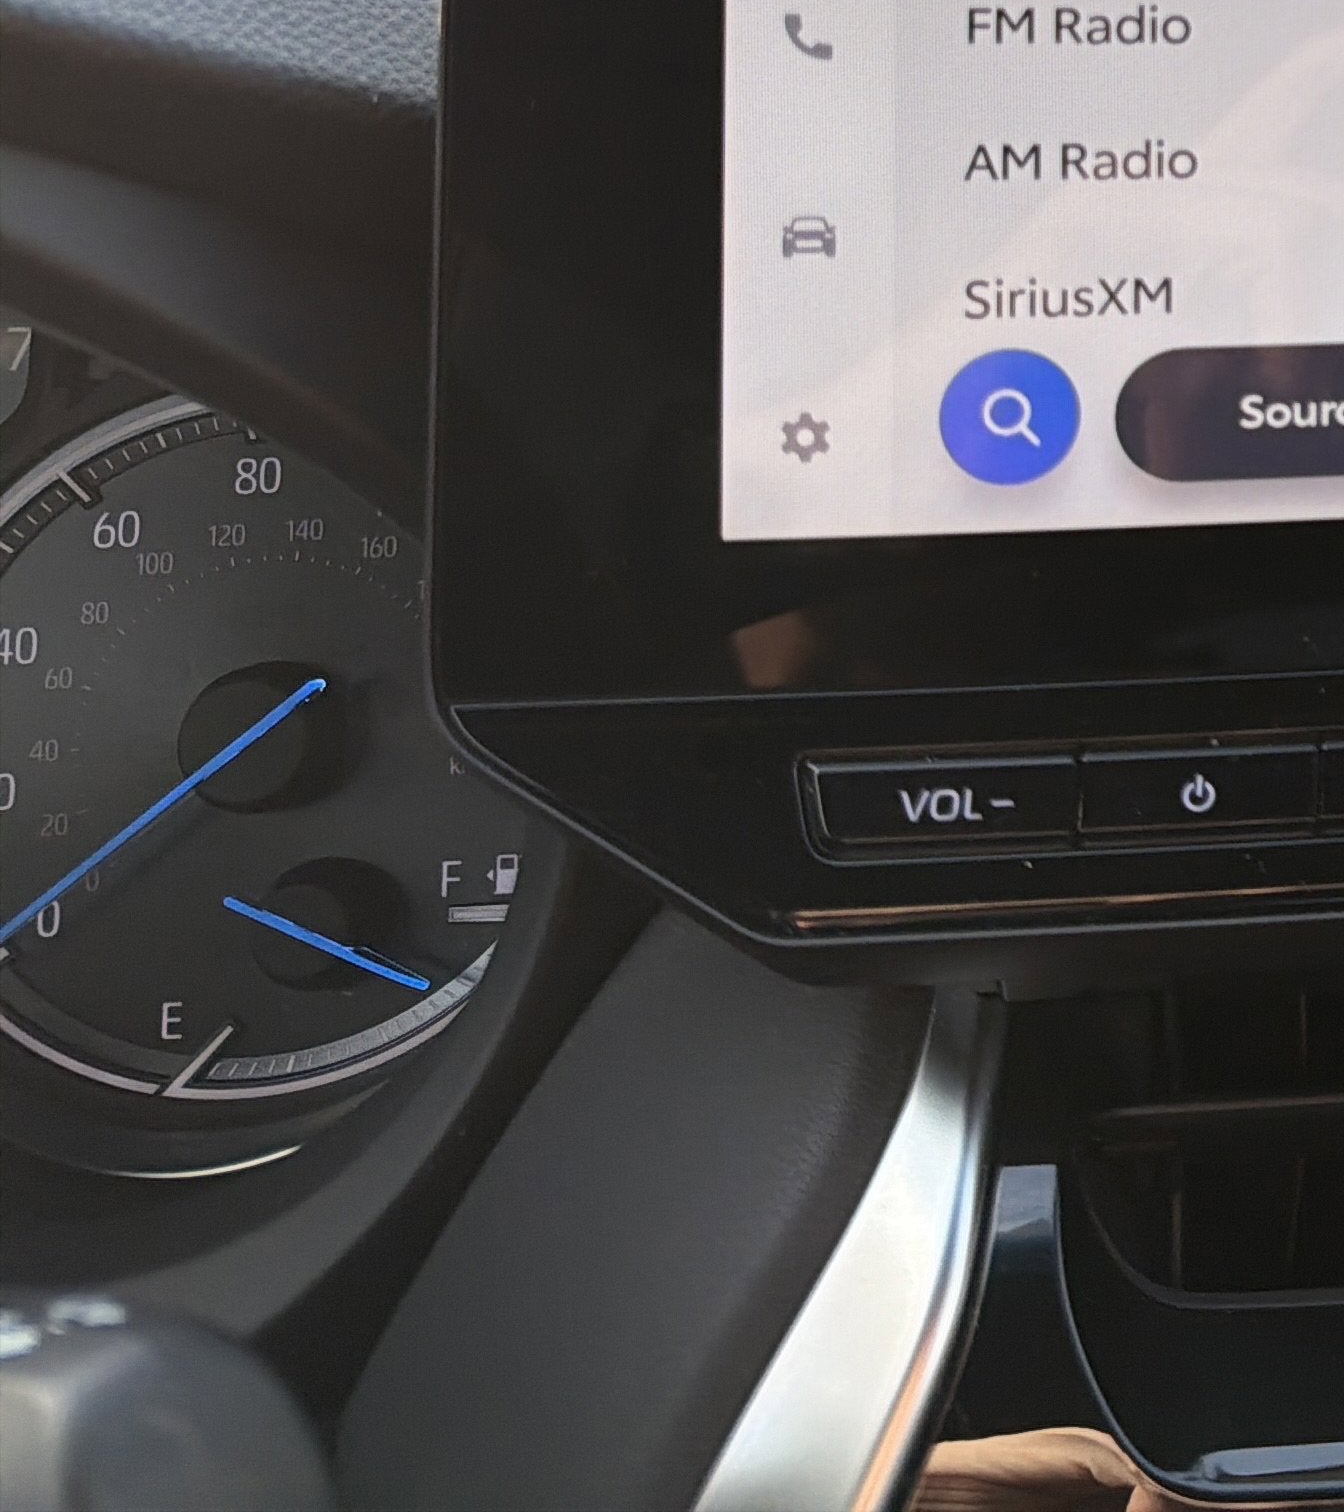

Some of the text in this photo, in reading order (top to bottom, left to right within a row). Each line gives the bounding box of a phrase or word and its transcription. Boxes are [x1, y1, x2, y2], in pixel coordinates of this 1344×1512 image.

[966, 3, 1191, 45] FM Radio
[964, 140, 1198, 182] AM Radio
[963, 276, 1174, 319] SiriusXM
[234, 457, 282, 495] 80
[93, 510, 141, 549] 60
[208, 518, 397, 559] 120 140 160
[136, 551, 174, 575] 100
[80, 601, 110, 625] 80
[0, 627, 38, 665] 40
[44, 666, 73, 690] 60
[29, 738, 60, 762] 40
[40, 813, 69, 837] 20
[441, 860, 463, 898] F
[37, 900, 61, 938] 0
[160, 1001, 183, 1040] E
